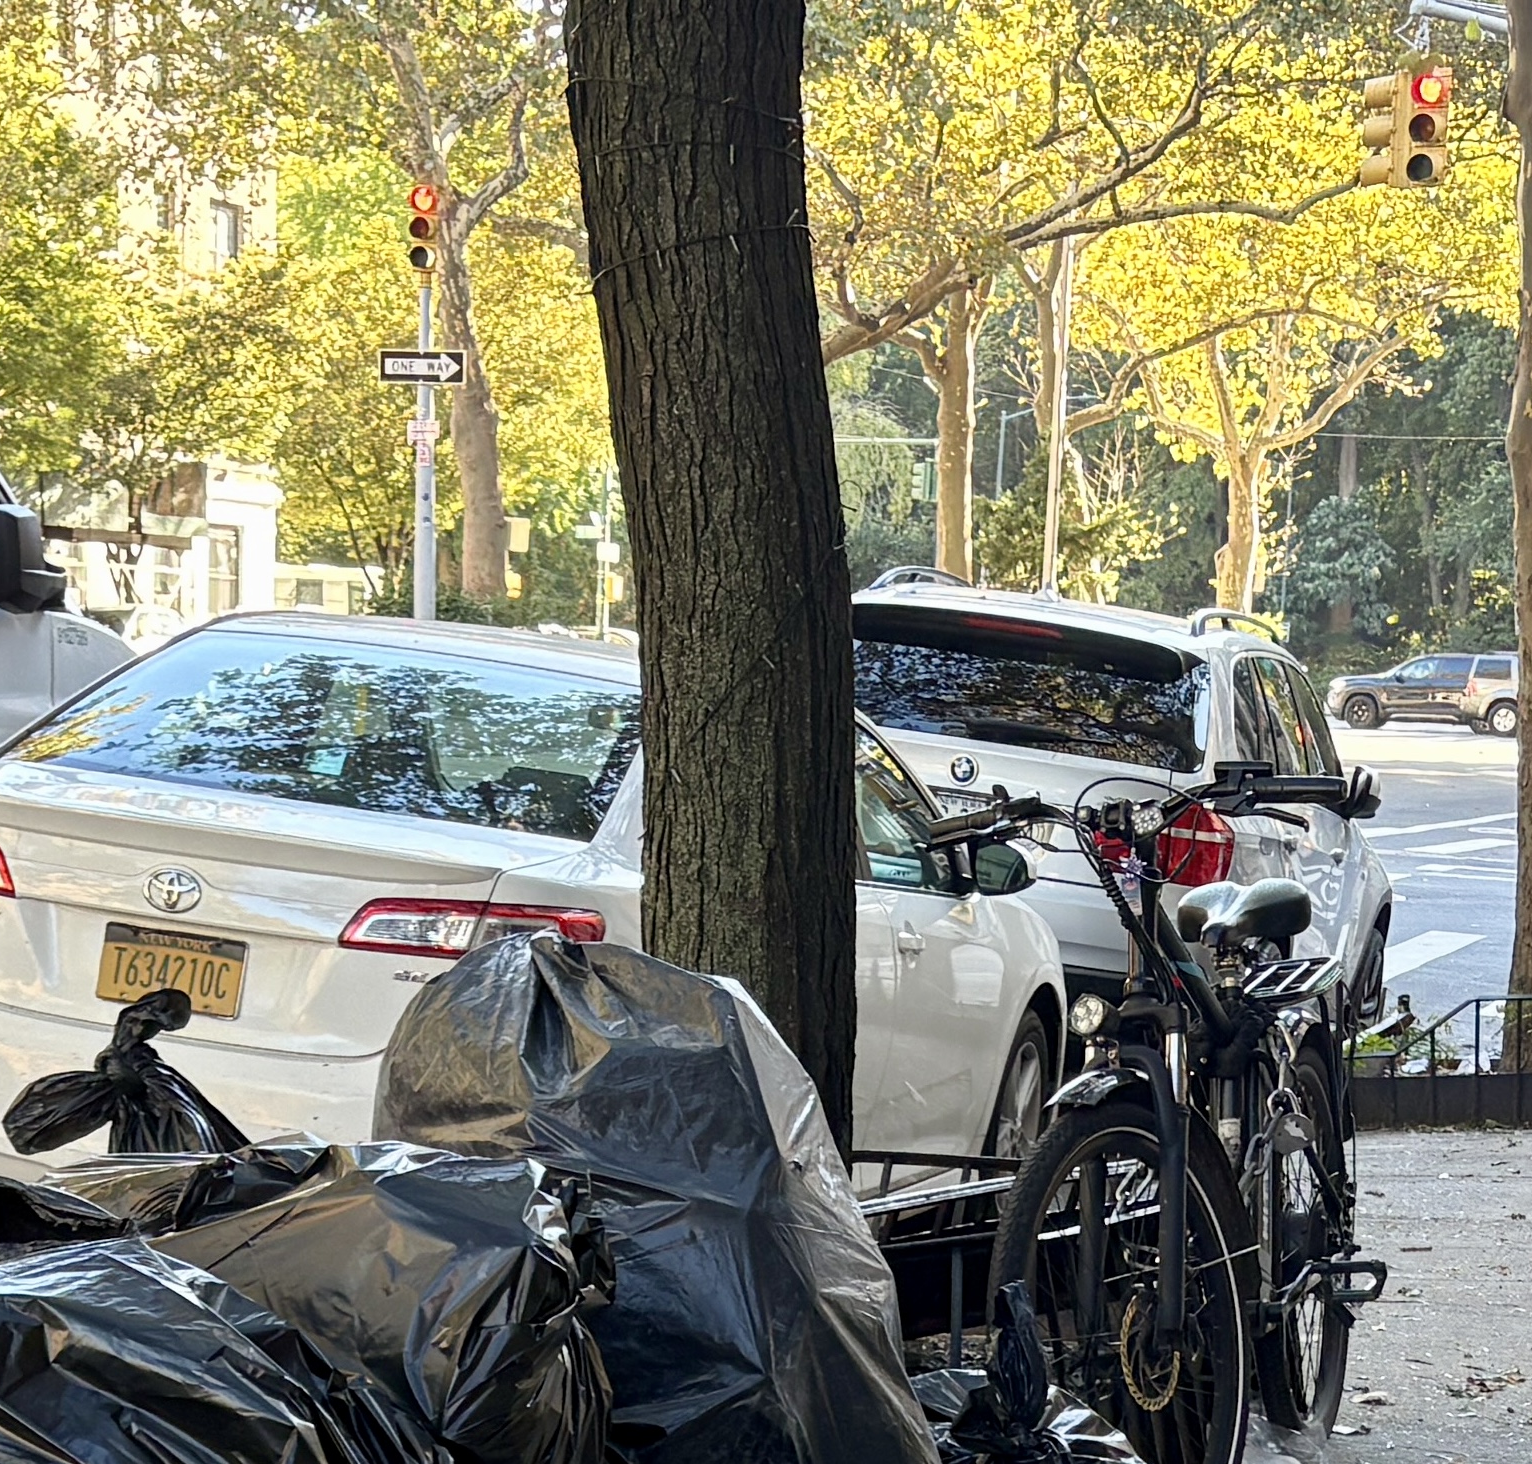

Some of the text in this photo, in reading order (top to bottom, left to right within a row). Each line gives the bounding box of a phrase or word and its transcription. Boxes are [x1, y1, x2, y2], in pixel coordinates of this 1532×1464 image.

[391, 360, 452, 373] ONE WAY
[138, 931, 214, 953] NEW YORK
[113, 946, 231, 1000] T634210C
